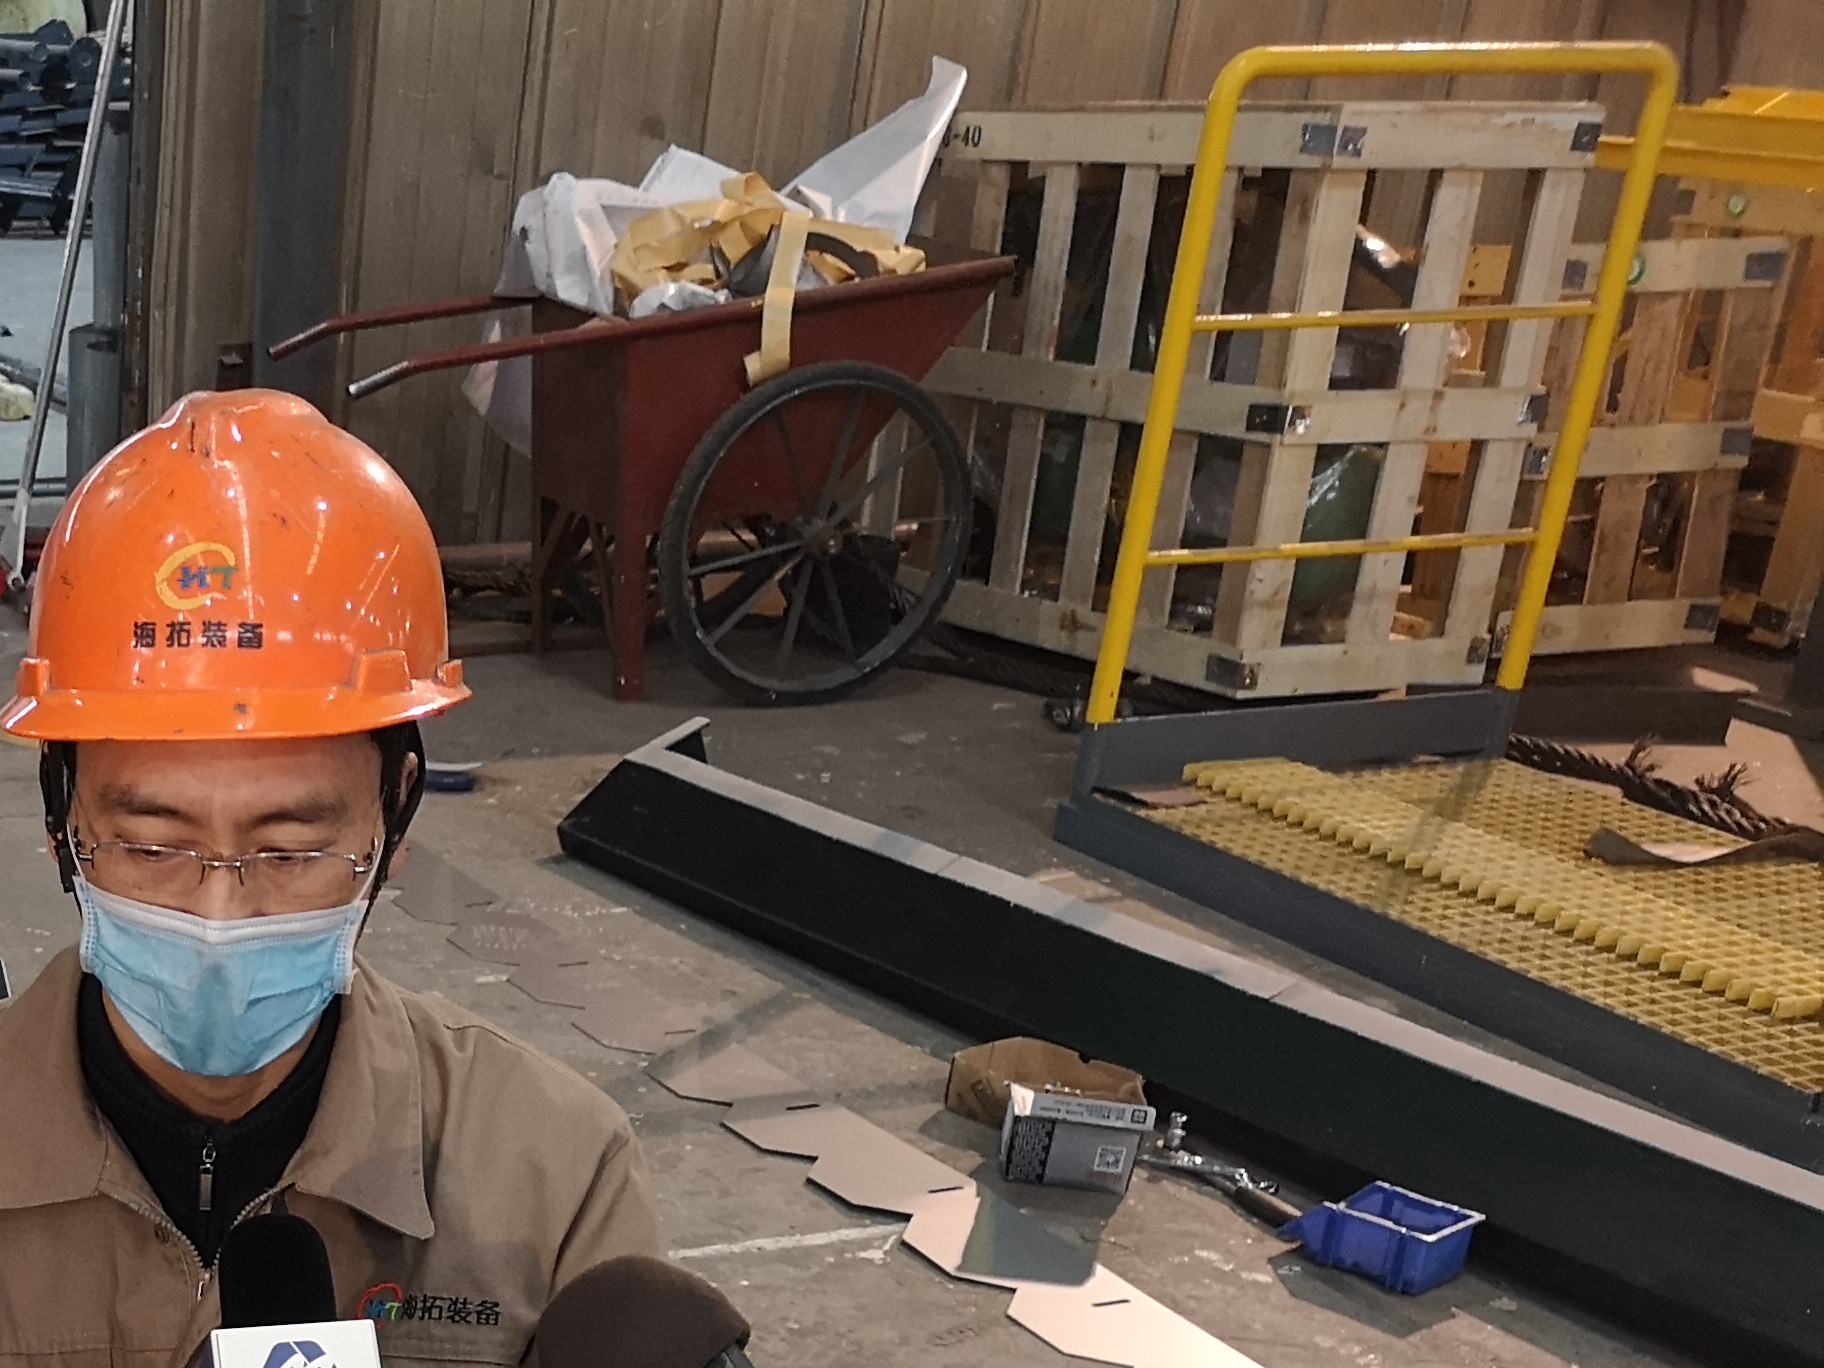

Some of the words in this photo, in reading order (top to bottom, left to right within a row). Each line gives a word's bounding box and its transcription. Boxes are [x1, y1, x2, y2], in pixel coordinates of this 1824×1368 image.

[178, 565, 239, 590] HT
[133, 620, 264, 649] 海拓装备
[401, 1293, 502, 1326] 海拓装备
